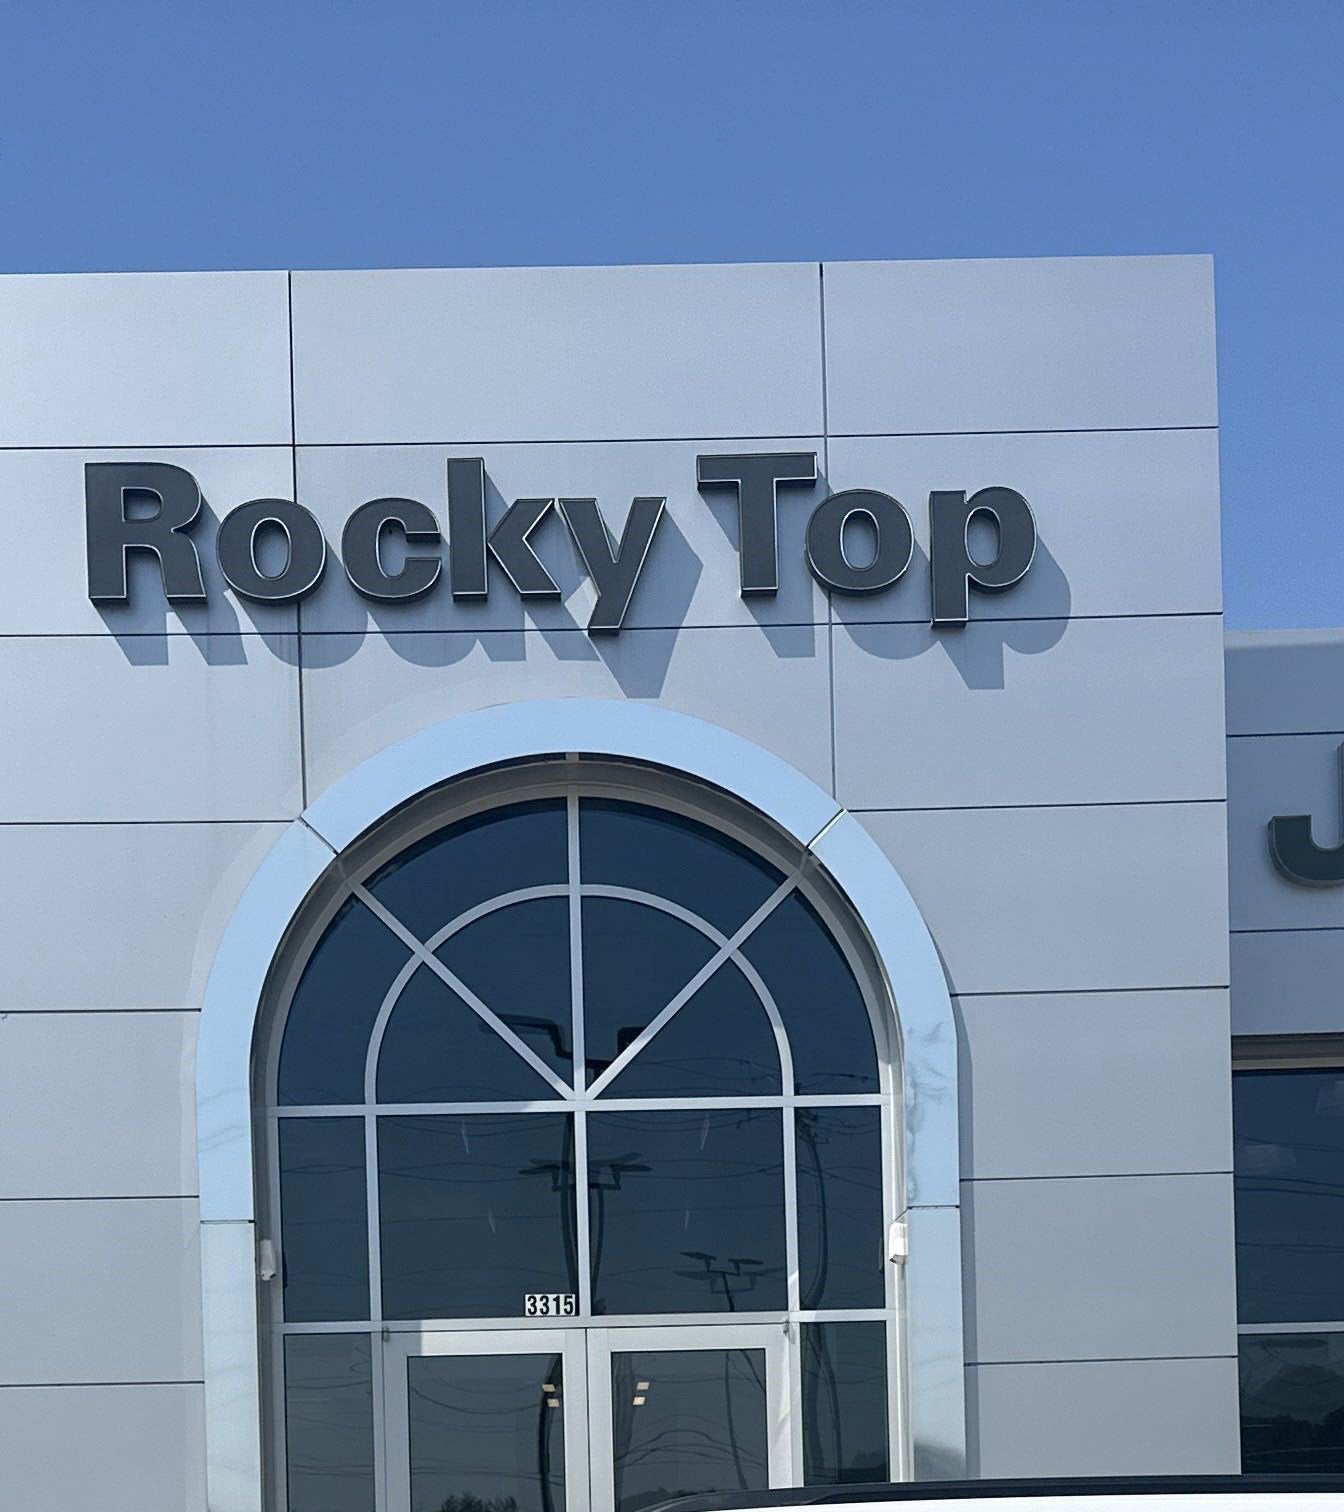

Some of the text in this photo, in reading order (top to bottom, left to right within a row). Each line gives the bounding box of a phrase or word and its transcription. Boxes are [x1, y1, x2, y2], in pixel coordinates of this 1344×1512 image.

[84, 452, 1038, 635] Rocky Top
[527, 1295, 574, 1315] 3315
